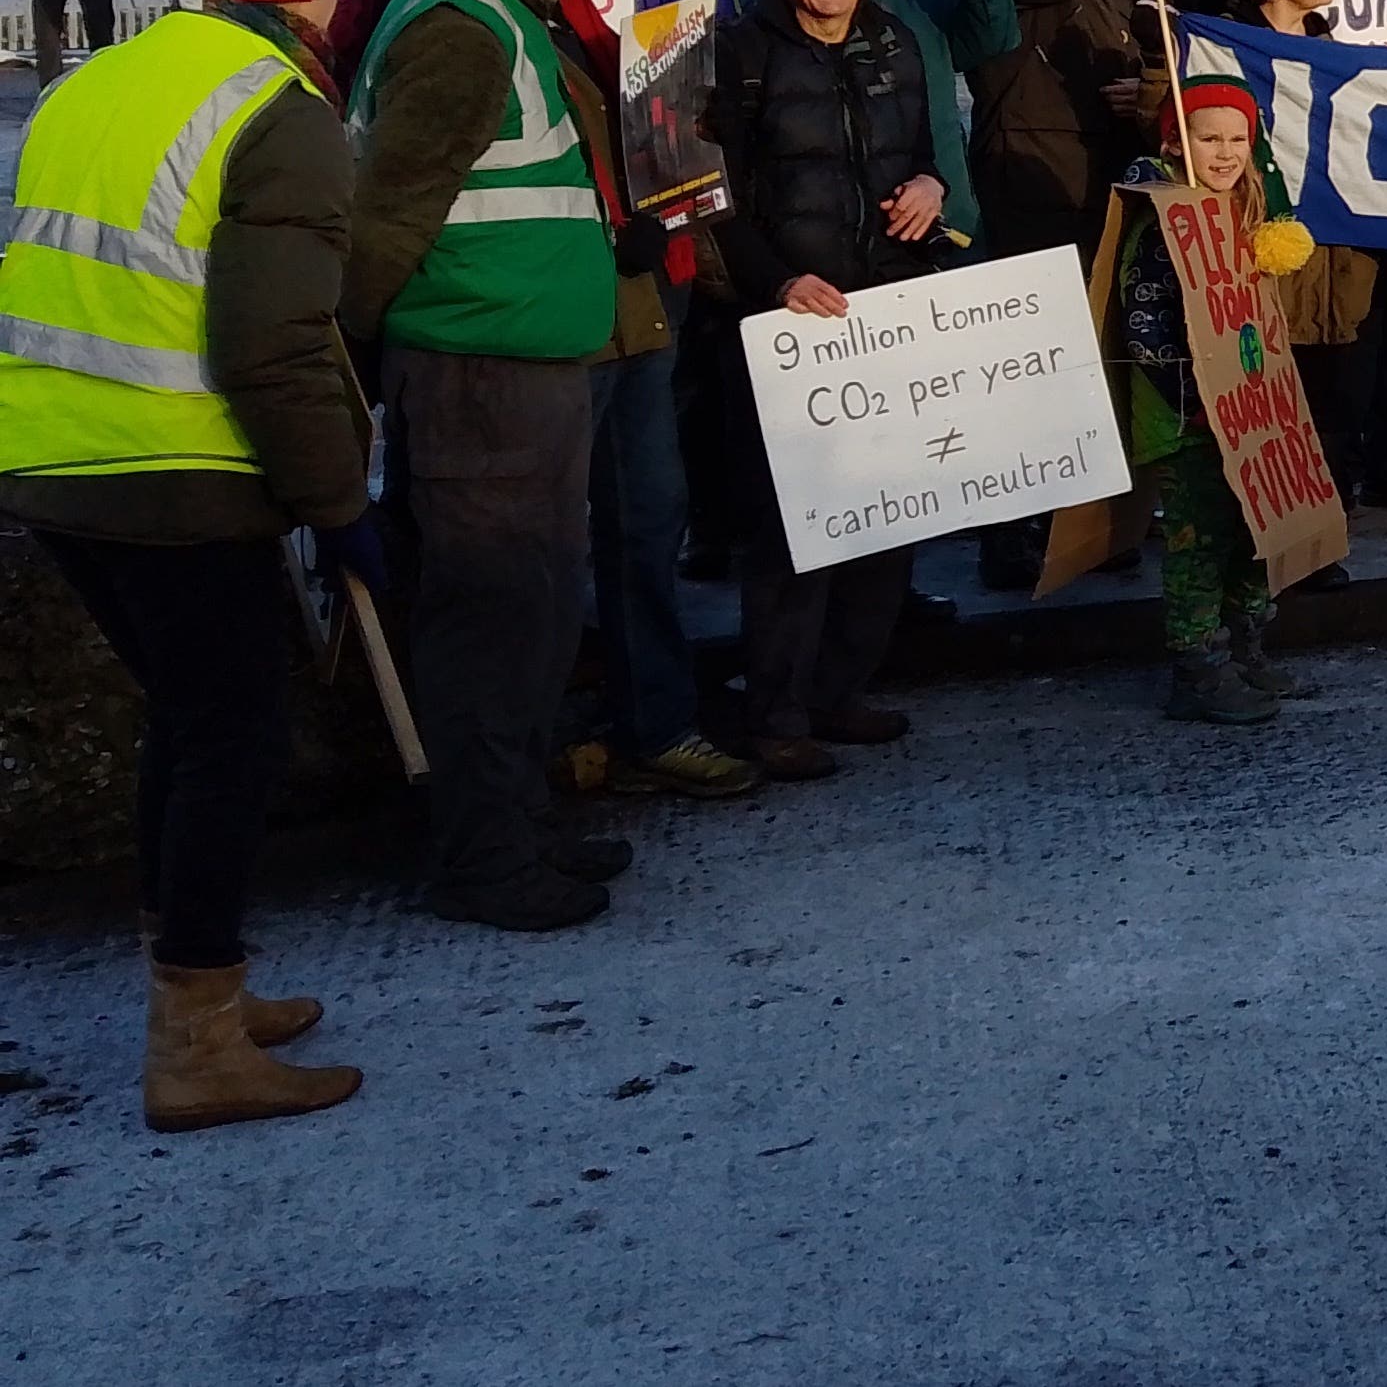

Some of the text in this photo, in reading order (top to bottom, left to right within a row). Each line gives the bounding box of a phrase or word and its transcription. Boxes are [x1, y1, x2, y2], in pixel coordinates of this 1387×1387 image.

[773, 285, 1041, 371] 9 million tonnes
[909, 368, 967, 417] per
[980, 341, 1065, 386] year
